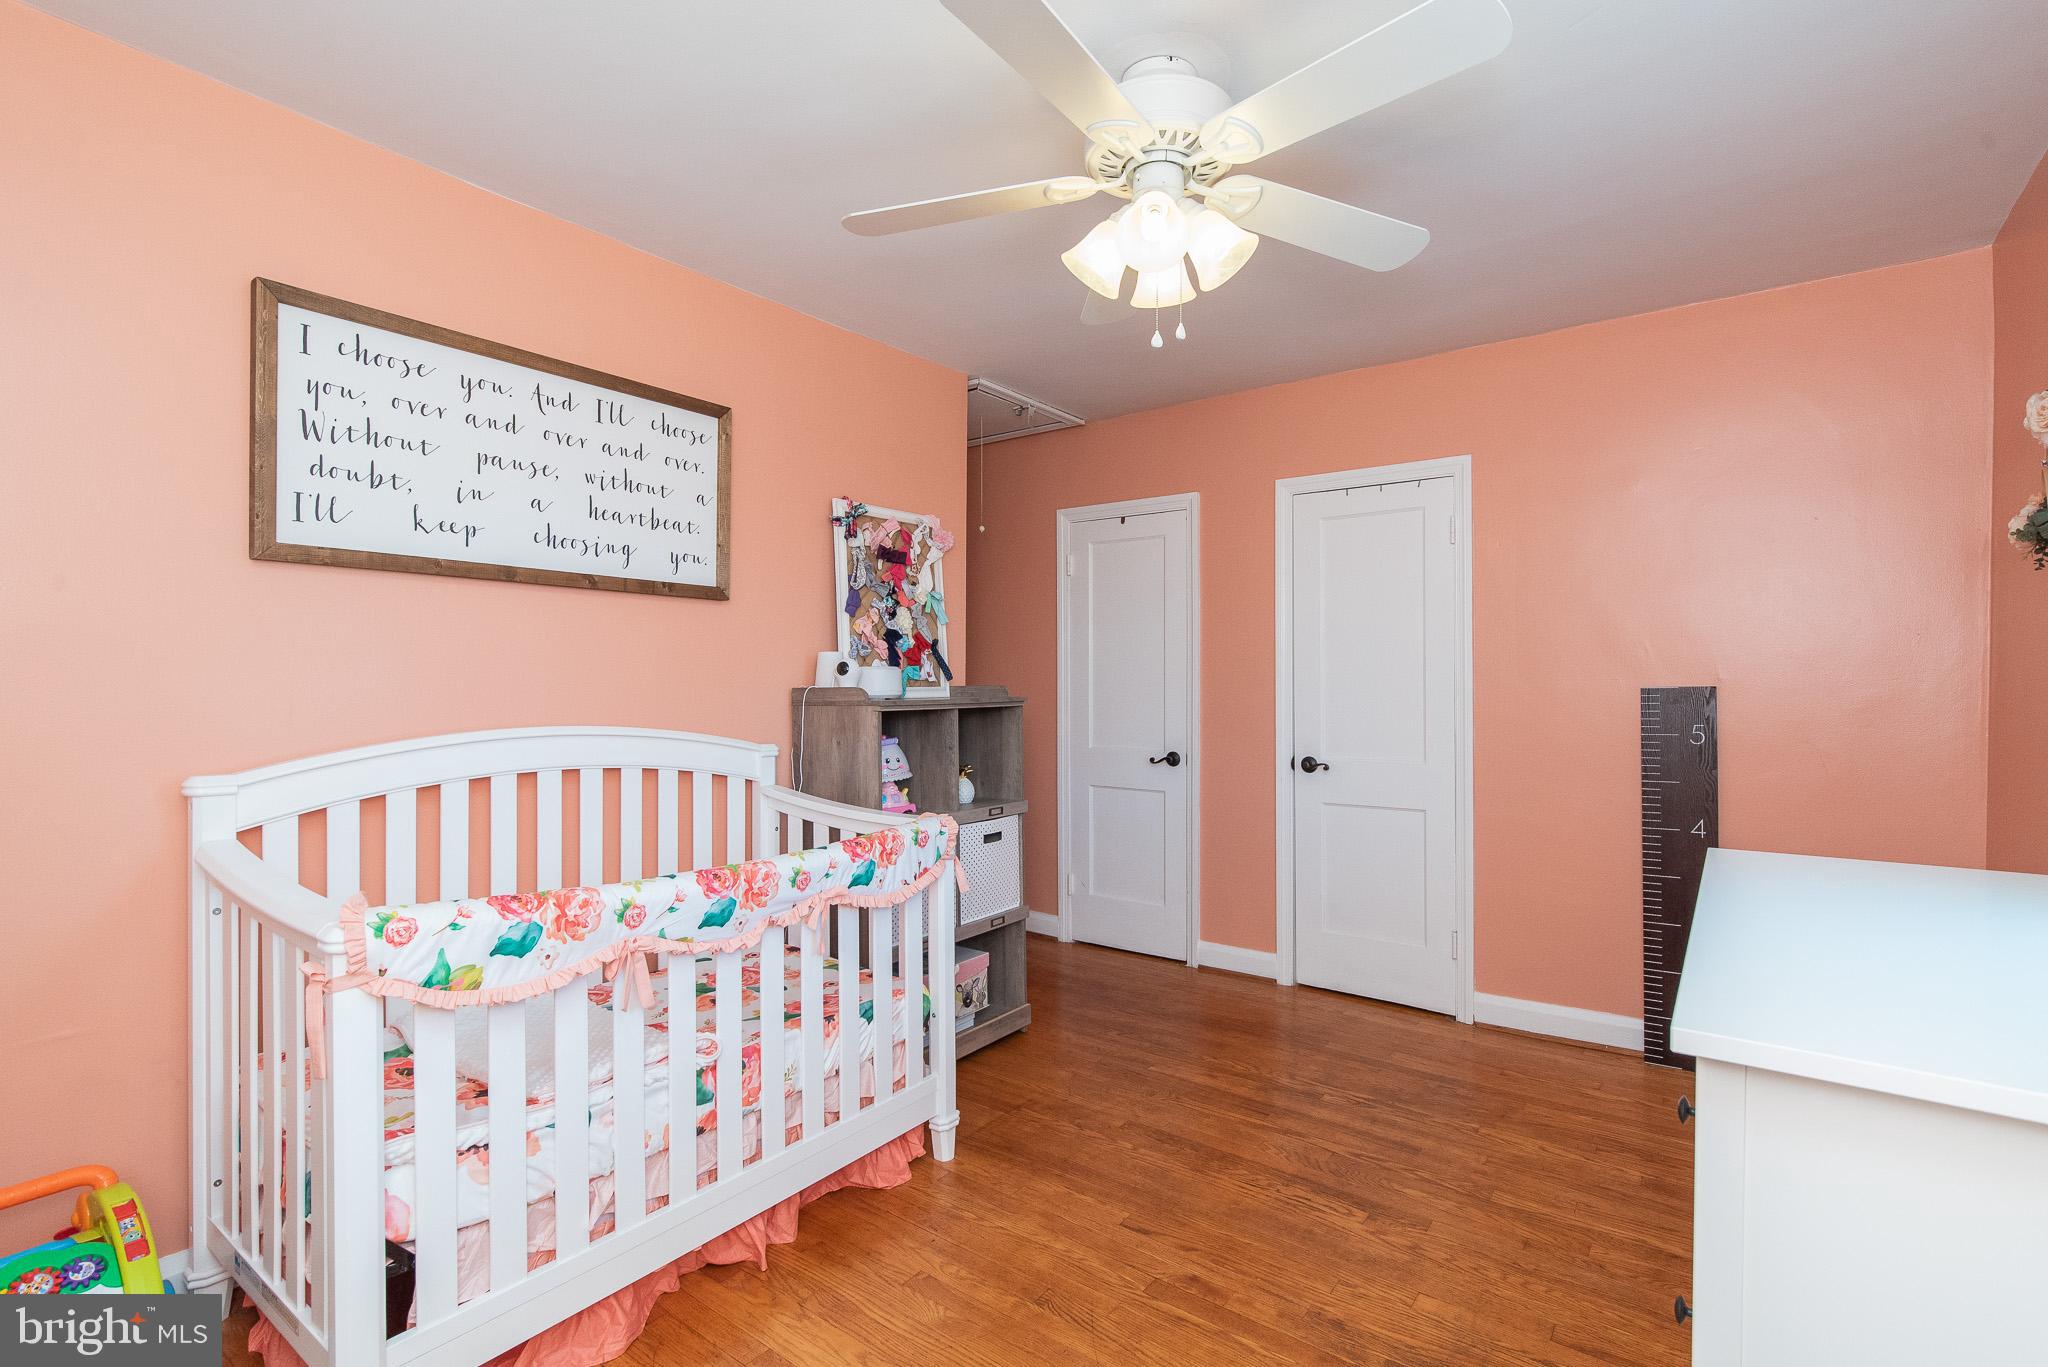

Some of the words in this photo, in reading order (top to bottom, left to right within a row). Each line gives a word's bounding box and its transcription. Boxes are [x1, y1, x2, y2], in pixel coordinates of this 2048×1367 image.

[298, 323, 312, 356] I
[337, 333, 437, 378] choose
[460, 374, 513, 404] you.
[531, 382, 580, 415] And
[594, 398, 635, 427] I'll
[651, 412, 712, 445] choose
[306, 378, 369, 411] you,
[391, 396, 448, 420] over
[465, 413, 525, 436] and
[543, 430, 588, 449] over
[602, 443, 650, 462] and
[664, 456, 705, 474] over.
[298, 408, 441, 456] Without
[477, 451, 560, 481] pause,
[585, 468, 674, 498] without
[696, 493, 714, 507] a
[309, 454, 413, 494] doubt,
[456, 480, 495, 505] in
[530, 497, 553, 513] a
[588, 495, 701, 535] heartbeat.
[292, 491, 353, 524] I'll
[413, 503, 485, 547] keep
[533, 523, 638, 570] choosing
[670, 551, 708, 576] you.
[1689, 724, 1706, 745] 5
[1691, 819, 1707, 839] 4
